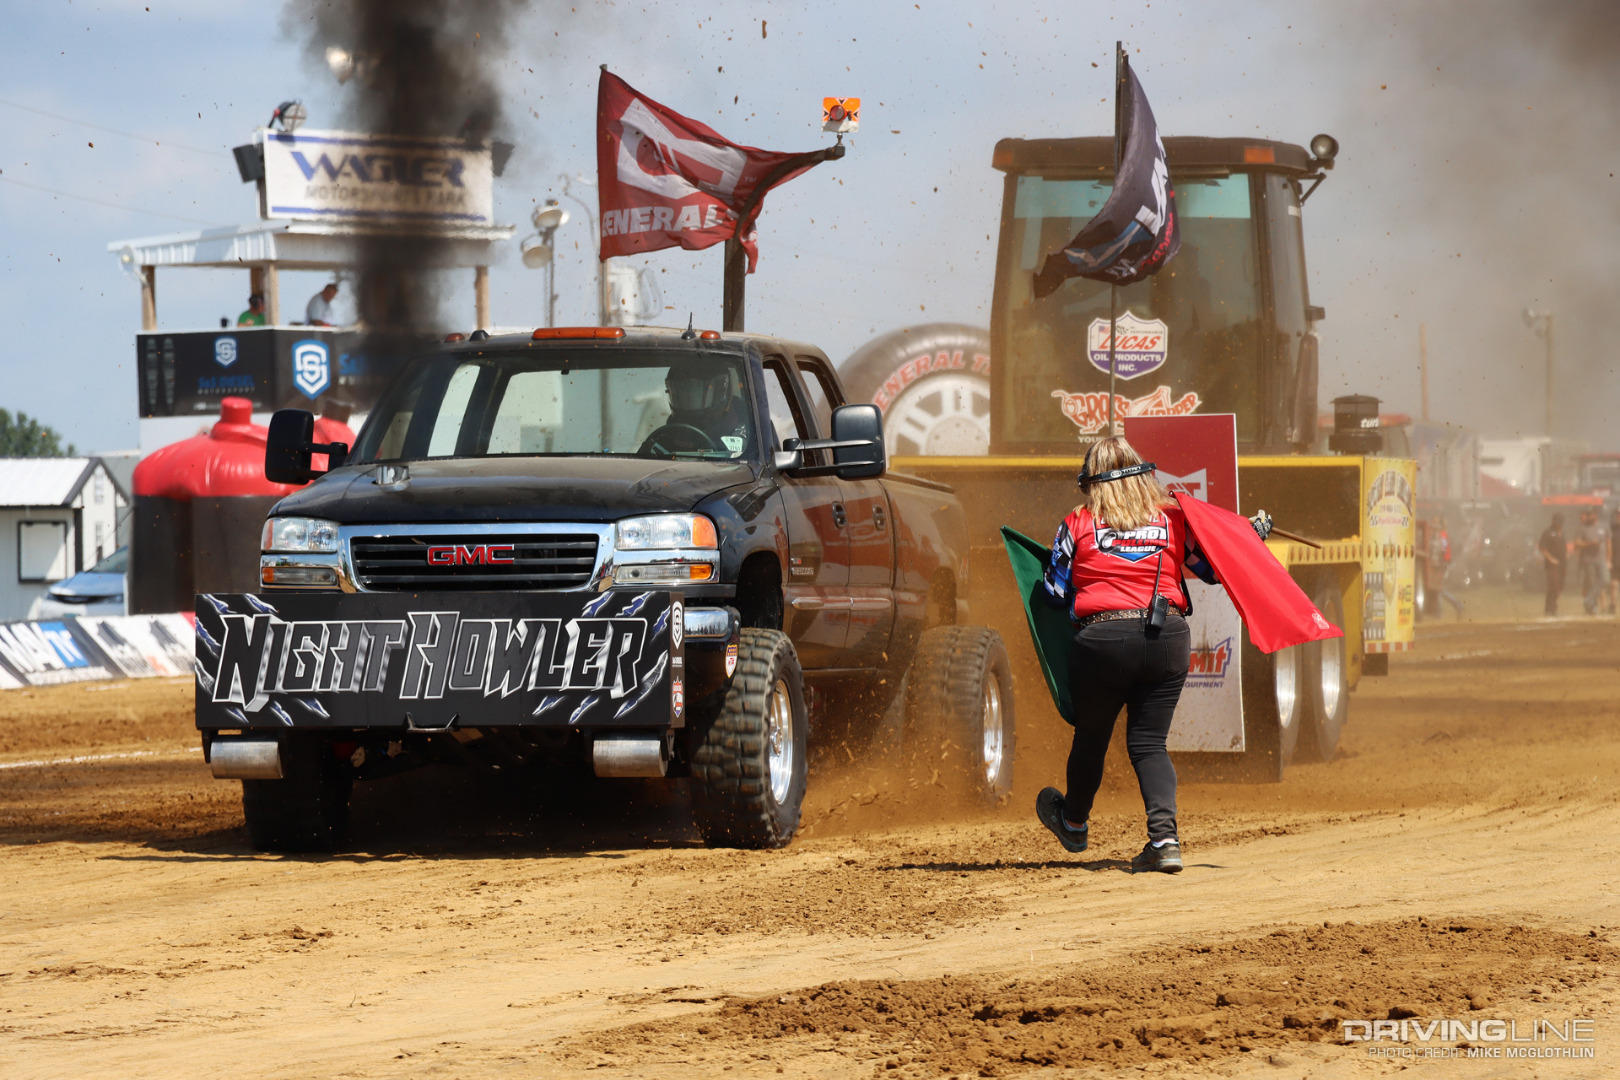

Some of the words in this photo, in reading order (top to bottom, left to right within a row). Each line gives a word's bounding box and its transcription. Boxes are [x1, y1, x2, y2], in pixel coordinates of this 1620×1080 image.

[1097, 335, 1162, 351] LUCAS
[1093, 353, 1110, 362] OIL
[1118, 363, 1138, 372] INC.
[870, 348, 967, 416] ENERAL
[1123, 530, 1161, 540] PRO
[427, 544, 515, 566] GMC
[1184, 681, 1224, 689] QUIPMENT
